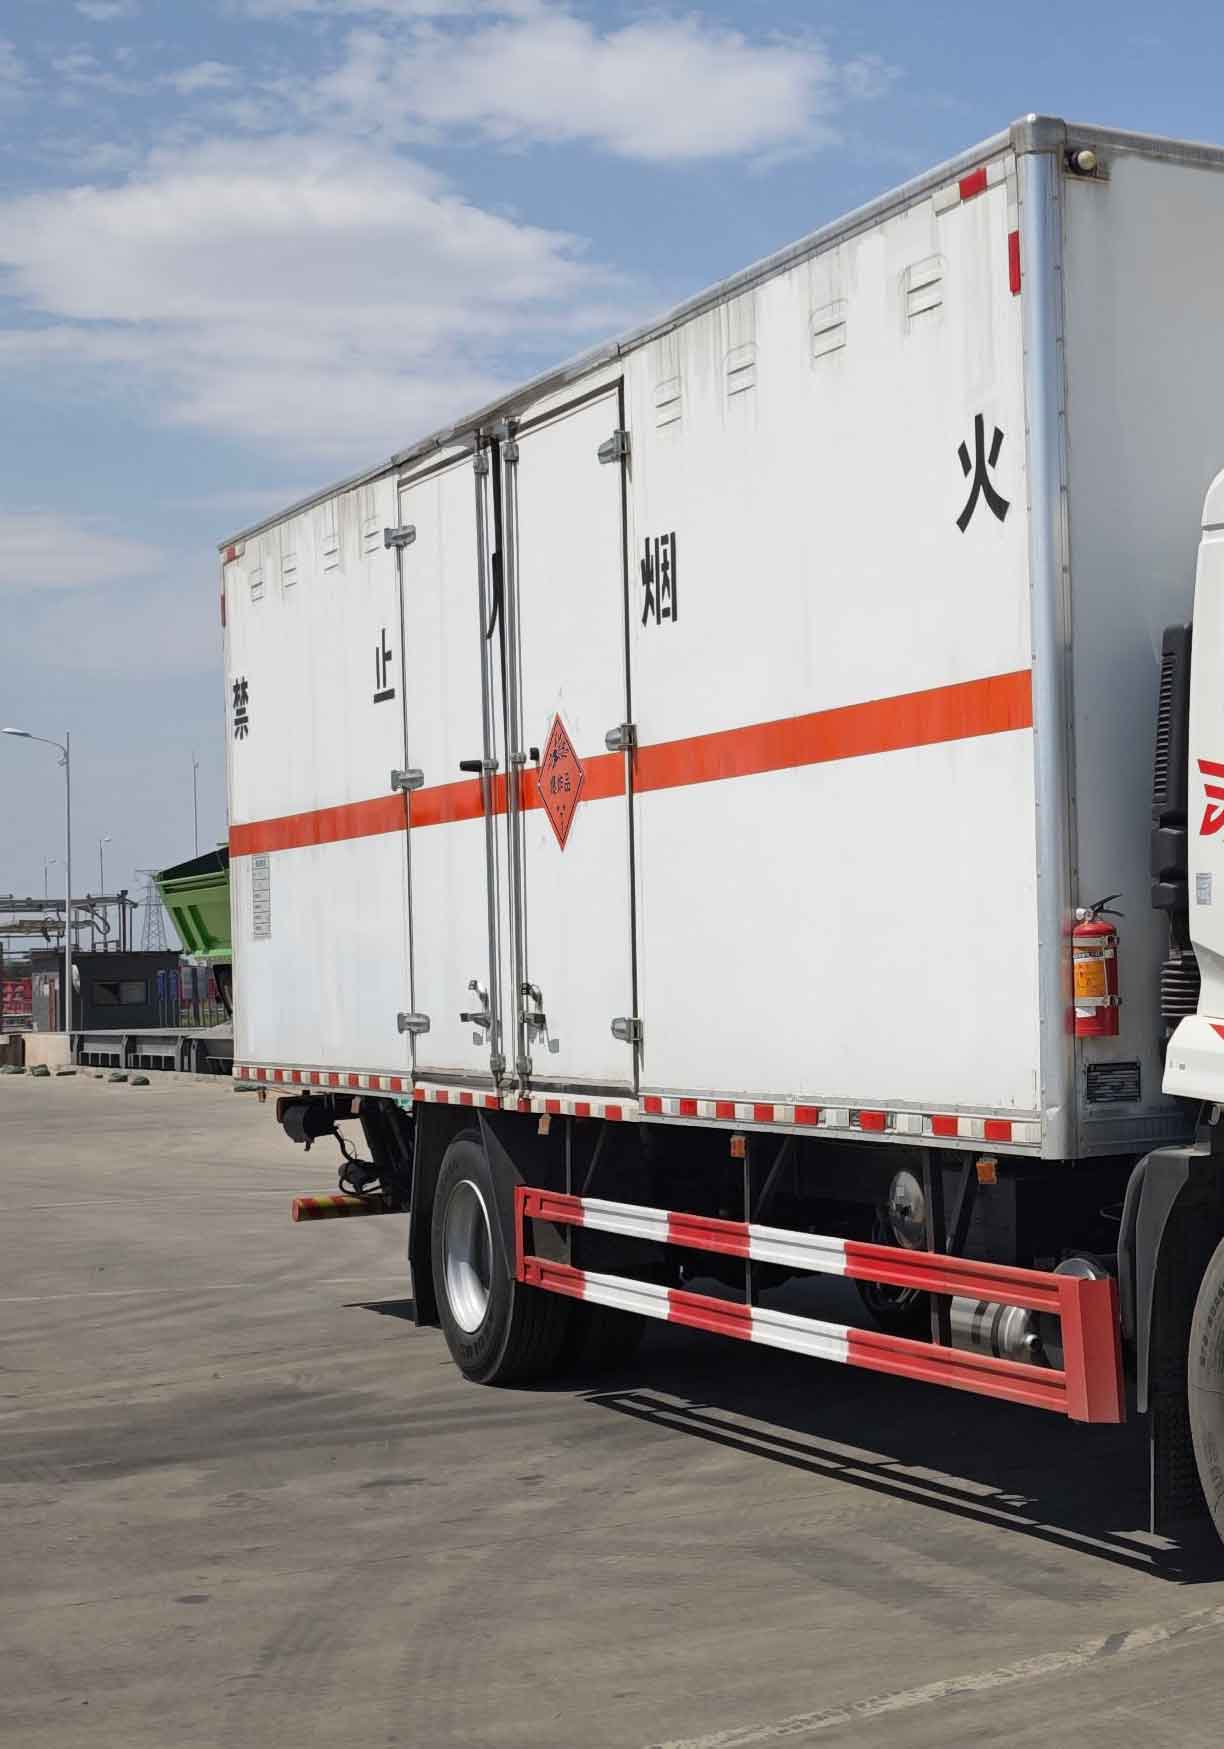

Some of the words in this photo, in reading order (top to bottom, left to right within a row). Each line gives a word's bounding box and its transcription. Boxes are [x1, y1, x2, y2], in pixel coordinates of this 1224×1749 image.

[233, 676, 249, 740] 禁
[373, 628, 396, 704] 止
[641, 531, 678, 627] 烟
[956, 413, 1010, 534] 火
